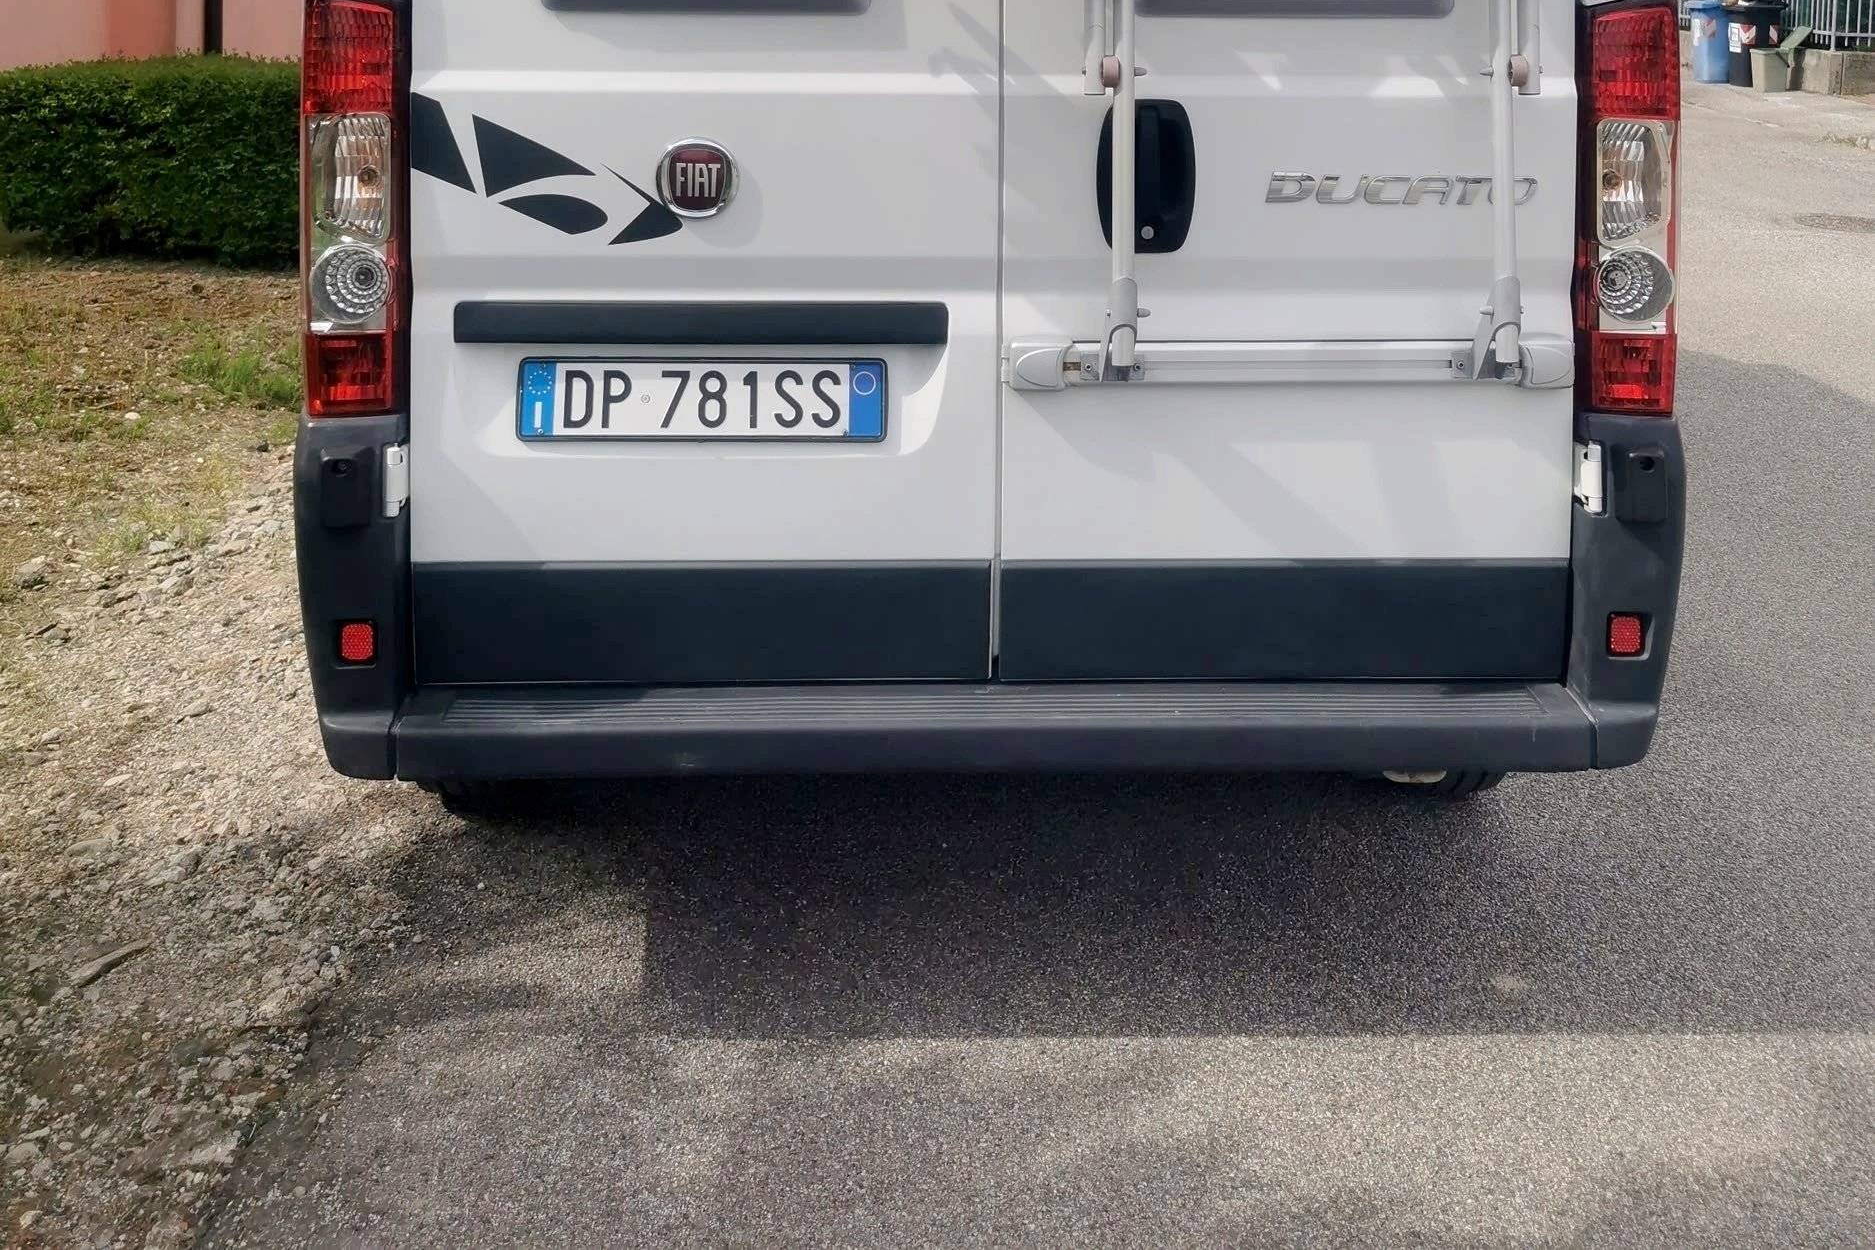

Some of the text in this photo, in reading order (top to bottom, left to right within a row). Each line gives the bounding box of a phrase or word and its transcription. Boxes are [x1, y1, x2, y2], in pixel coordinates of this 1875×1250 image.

[675, 162, 721, 198] FIAT
[562, 369, 842, 430] DP 781SS
